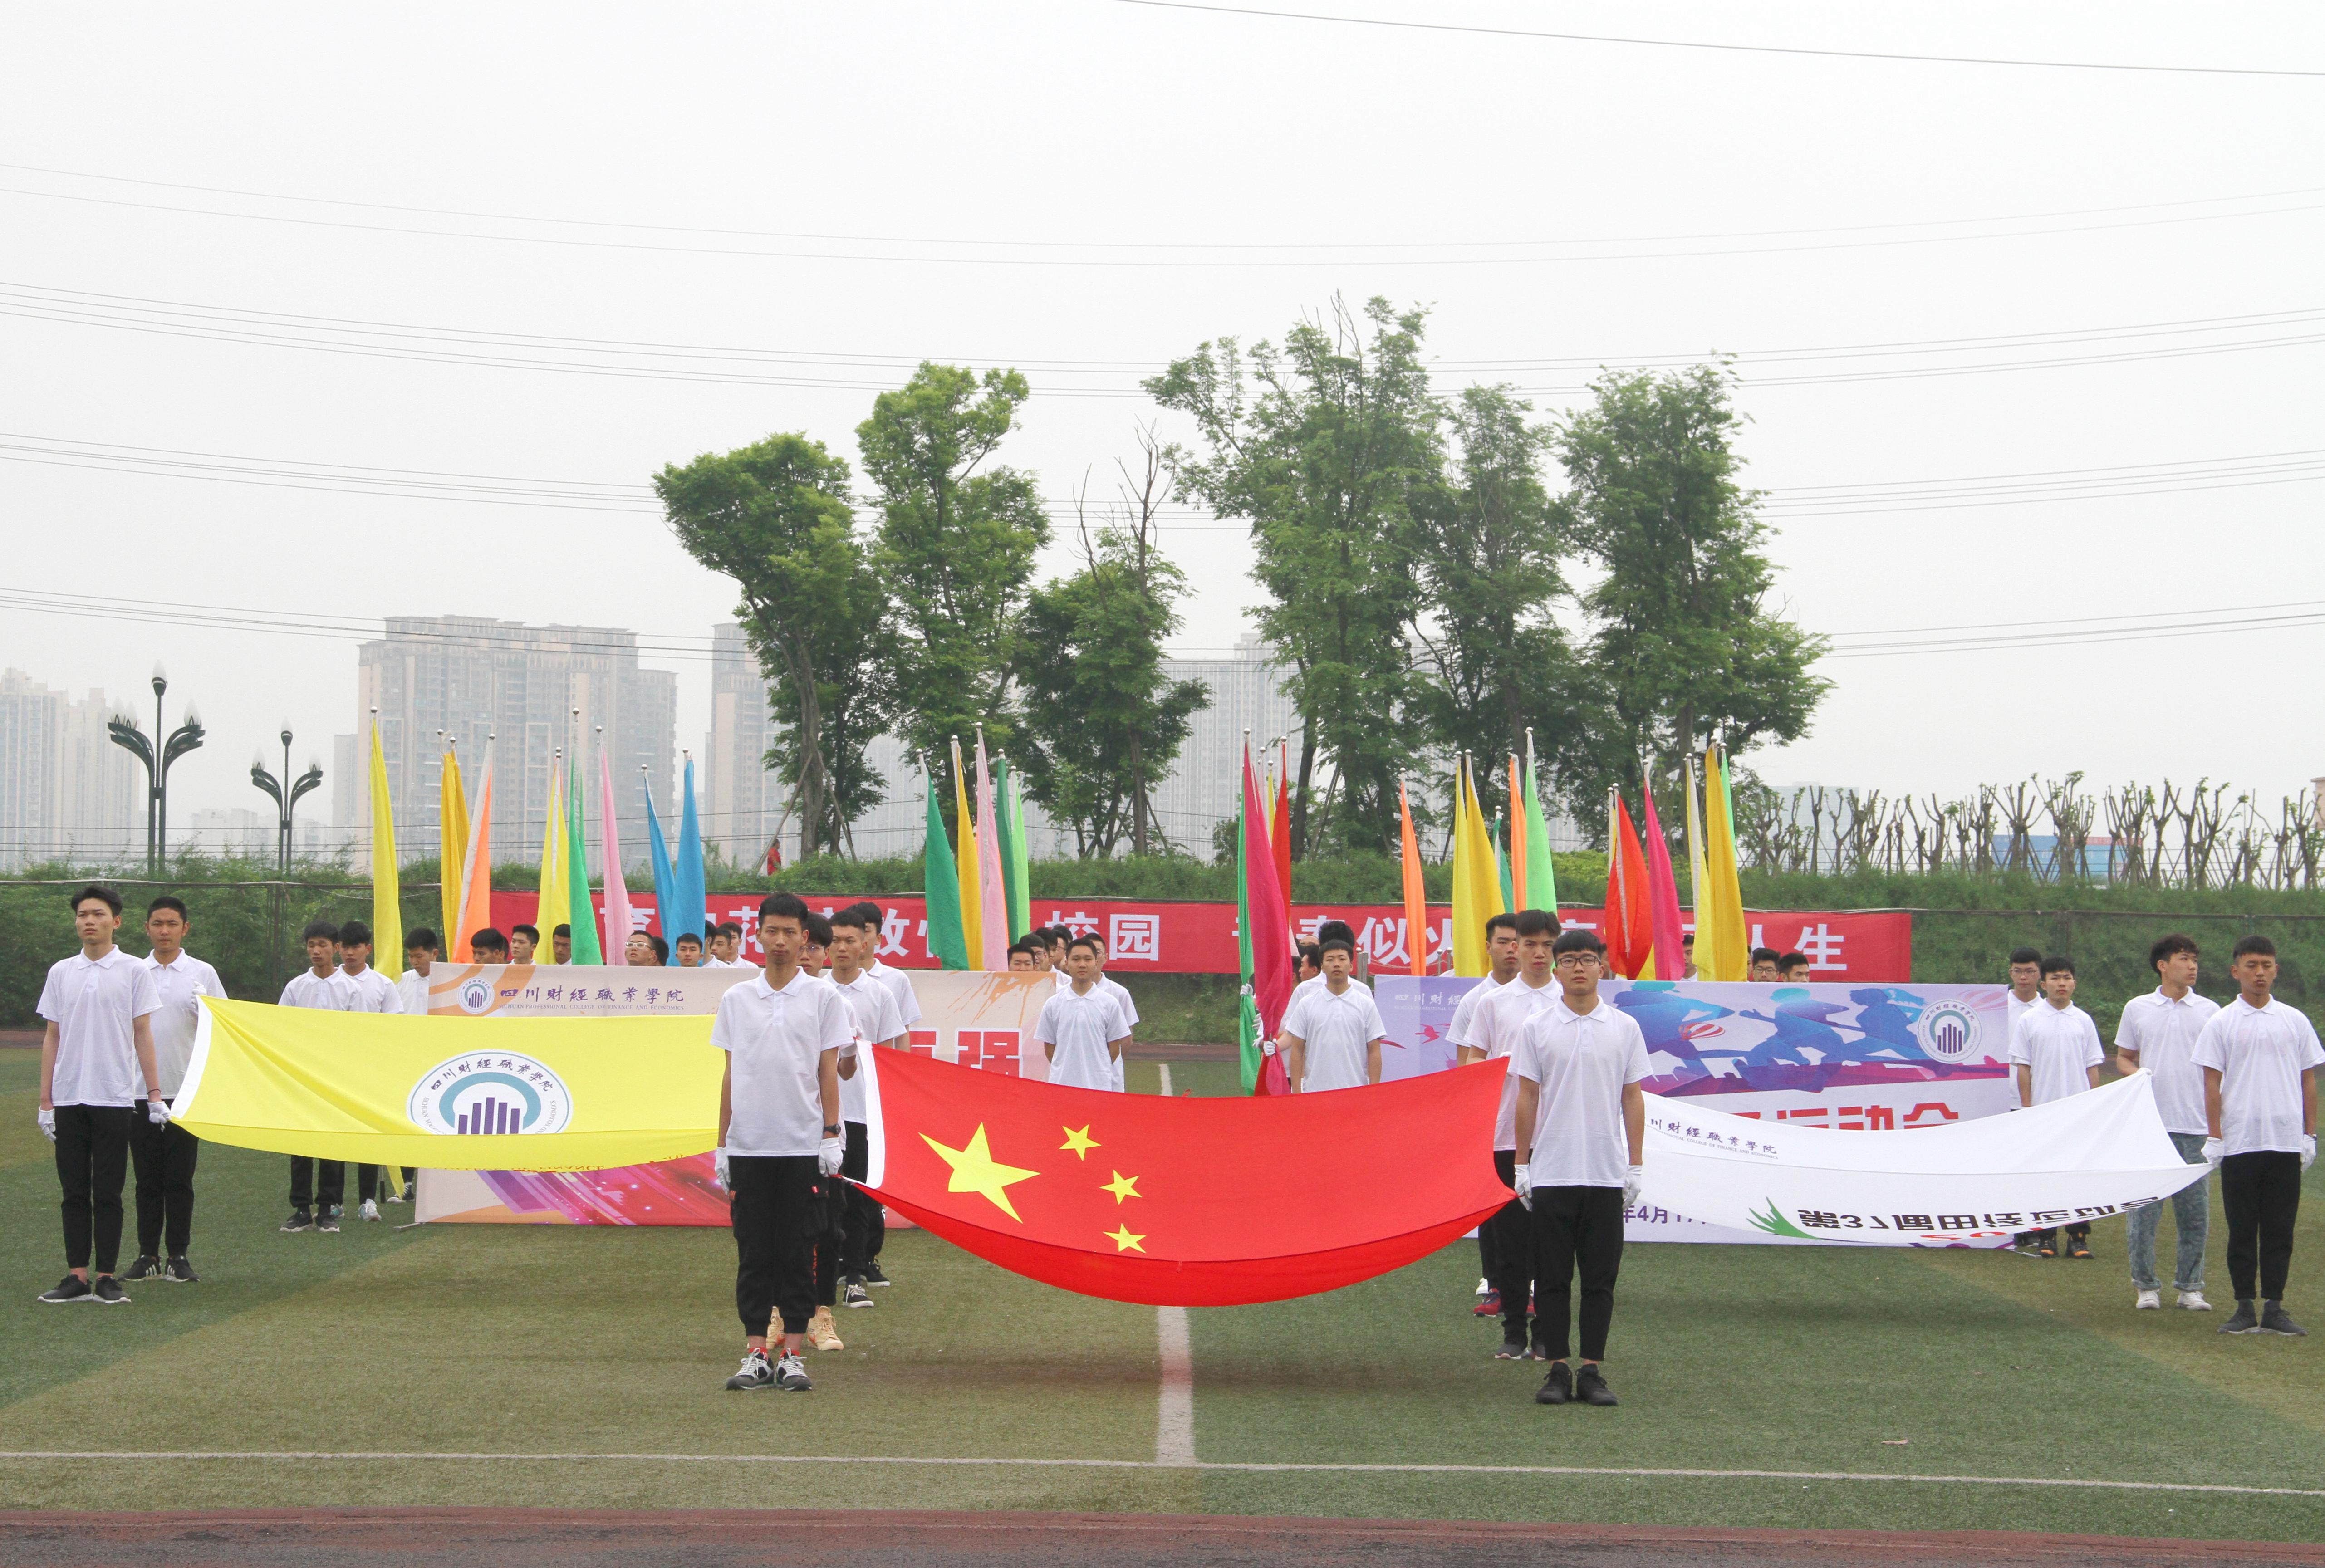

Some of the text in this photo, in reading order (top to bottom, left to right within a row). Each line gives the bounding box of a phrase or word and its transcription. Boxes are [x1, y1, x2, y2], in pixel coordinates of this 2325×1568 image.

[545, 1100, 557, 1127] ECONOMICS
[1687, 1138, 1707, 1146] COLLEGE
[1751, 1151, 1778, 1159] ECONOMICS
